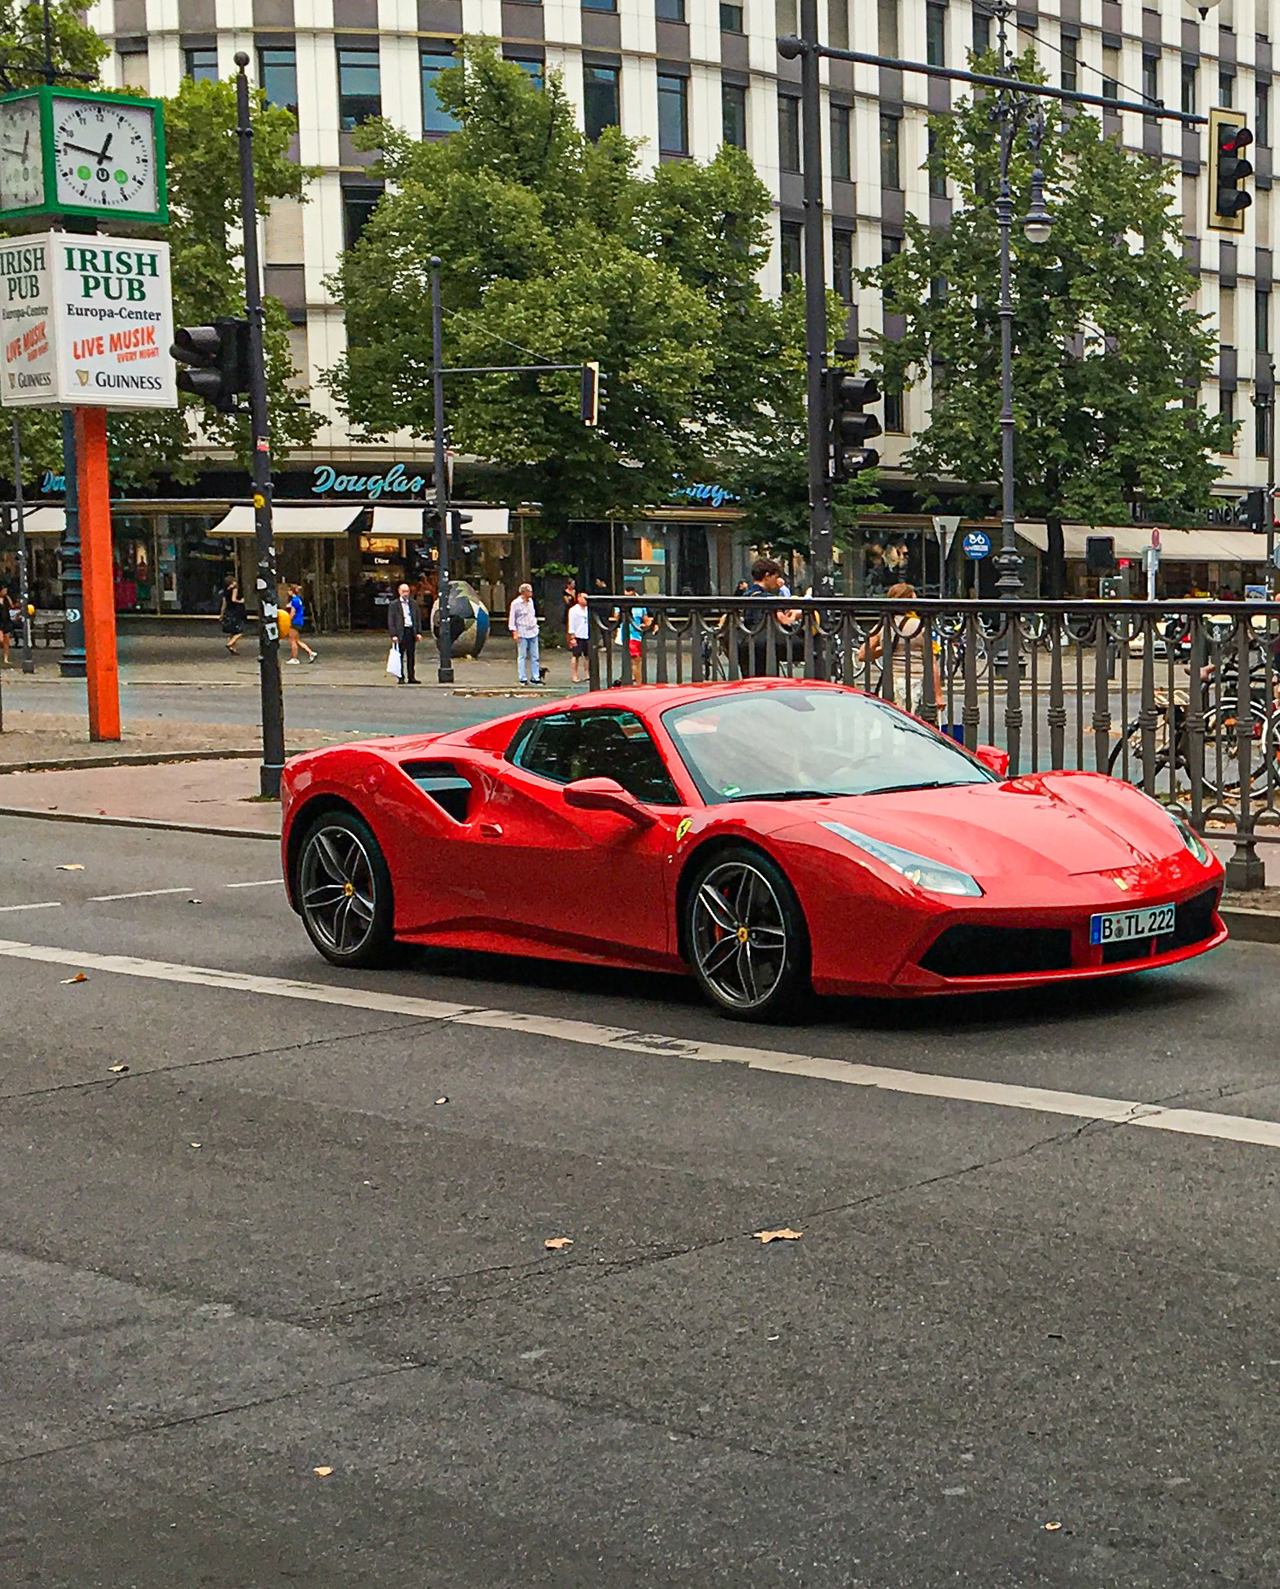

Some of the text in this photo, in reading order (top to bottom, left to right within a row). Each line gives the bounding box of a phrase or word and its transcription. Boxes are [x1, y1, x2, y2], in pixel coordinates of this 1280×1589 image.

[96, 114, 104, 123] 12
[0, 247, 46, 276] IRISH
[64, 247, 160, 277] IRISH
[7, 274, 40, 301] PUB
[80, 274, 147, 302] PUB
[2, 305, 49, 321] Europa-Center
[66, 303, 161, 321] Europa-Center
[6, 337, 22, 363] LIVE
[73, 336, 104, 360] LIVE
[109, 325, 156, 352] MUSIK
[117, 347, 160, 363] EVERY NIGHT
[17, 372, 52, 389] GUINNESS
[95, 371, 162, 390] GUINNESS
[311, 463, 425, 500] Douglas
[1102, 908, 1174, 939] B TL 222
